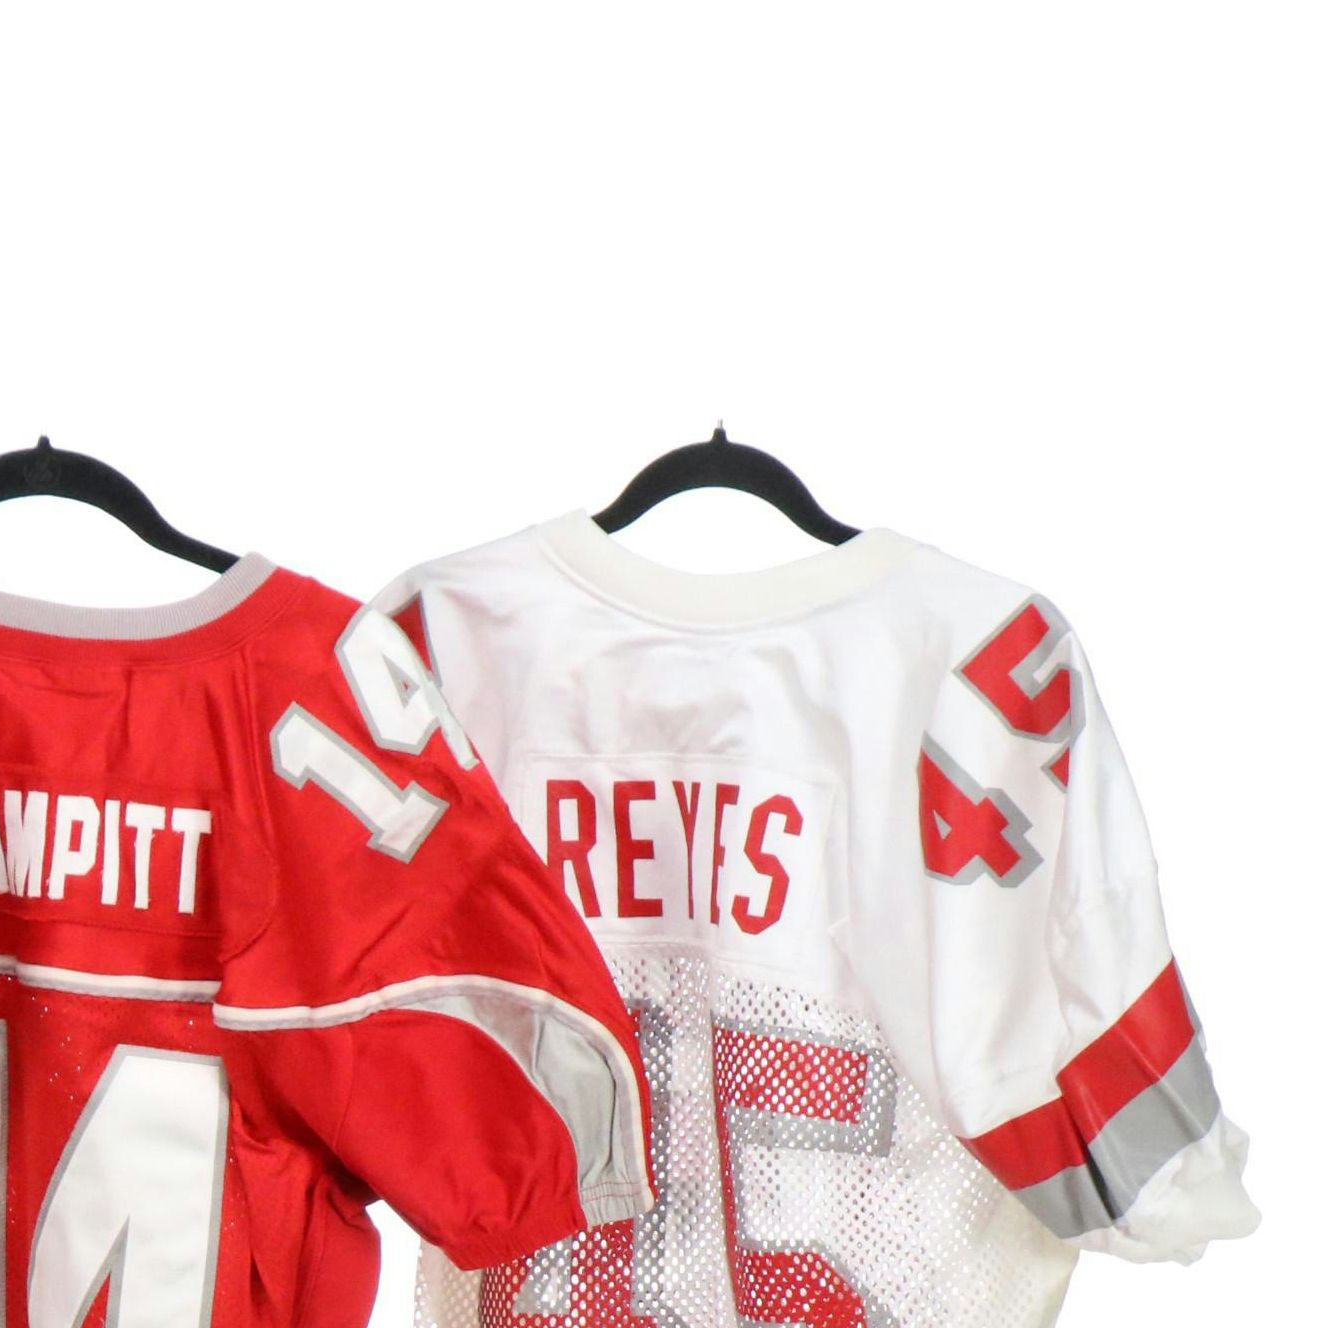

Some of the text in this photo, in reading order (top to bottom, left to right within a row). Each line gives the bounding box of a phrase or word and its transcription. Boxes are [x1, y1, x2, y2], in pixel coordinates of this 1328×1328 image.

[270, 603, 480, 864] 14
[546, 779, 804, 936] REYES
[916, 593, 1086, 889] 45
